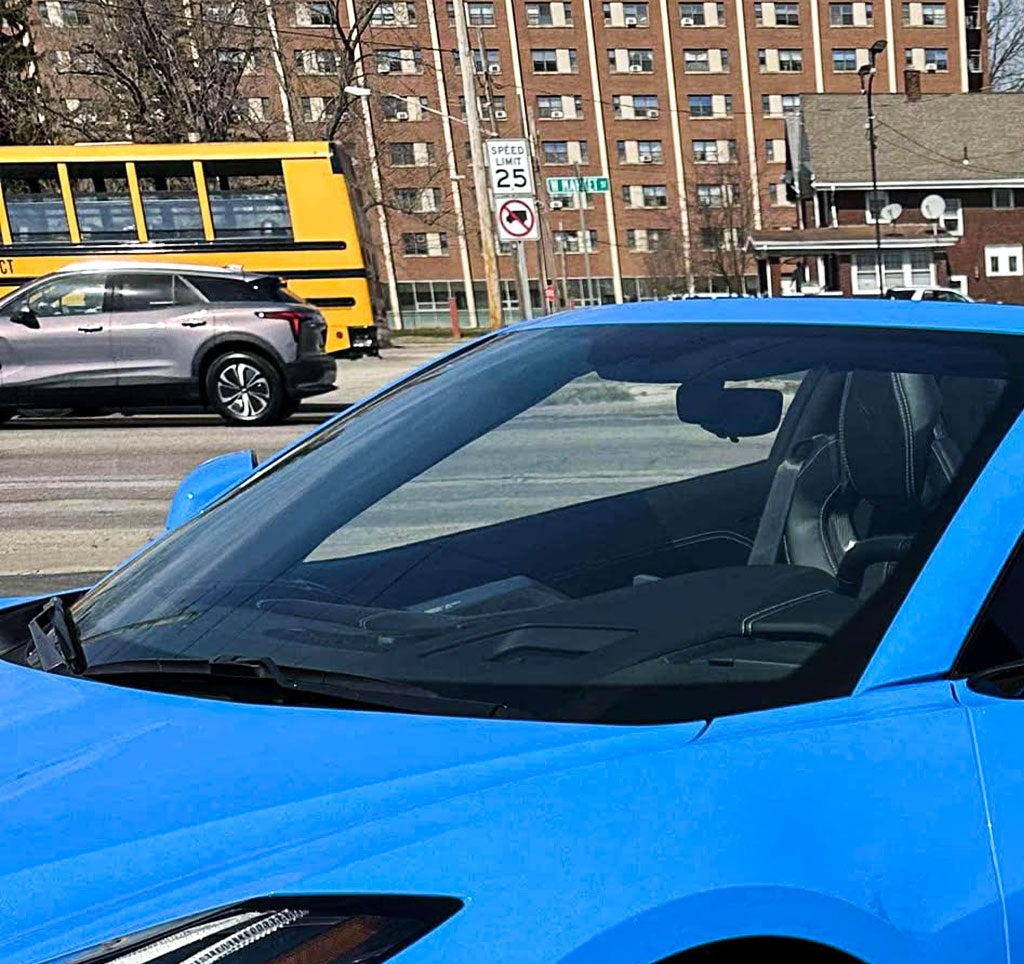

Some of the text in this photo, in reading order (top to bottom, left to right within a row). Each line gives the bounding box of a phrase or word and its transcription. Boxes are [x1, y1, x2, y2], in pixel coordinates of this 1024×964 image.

[491, 146, 524, 155] SPEED
[496, 157, 521, 166] LIMIT
[495, 169, 527, 188] 25
[548, 179, 559, 192] W
